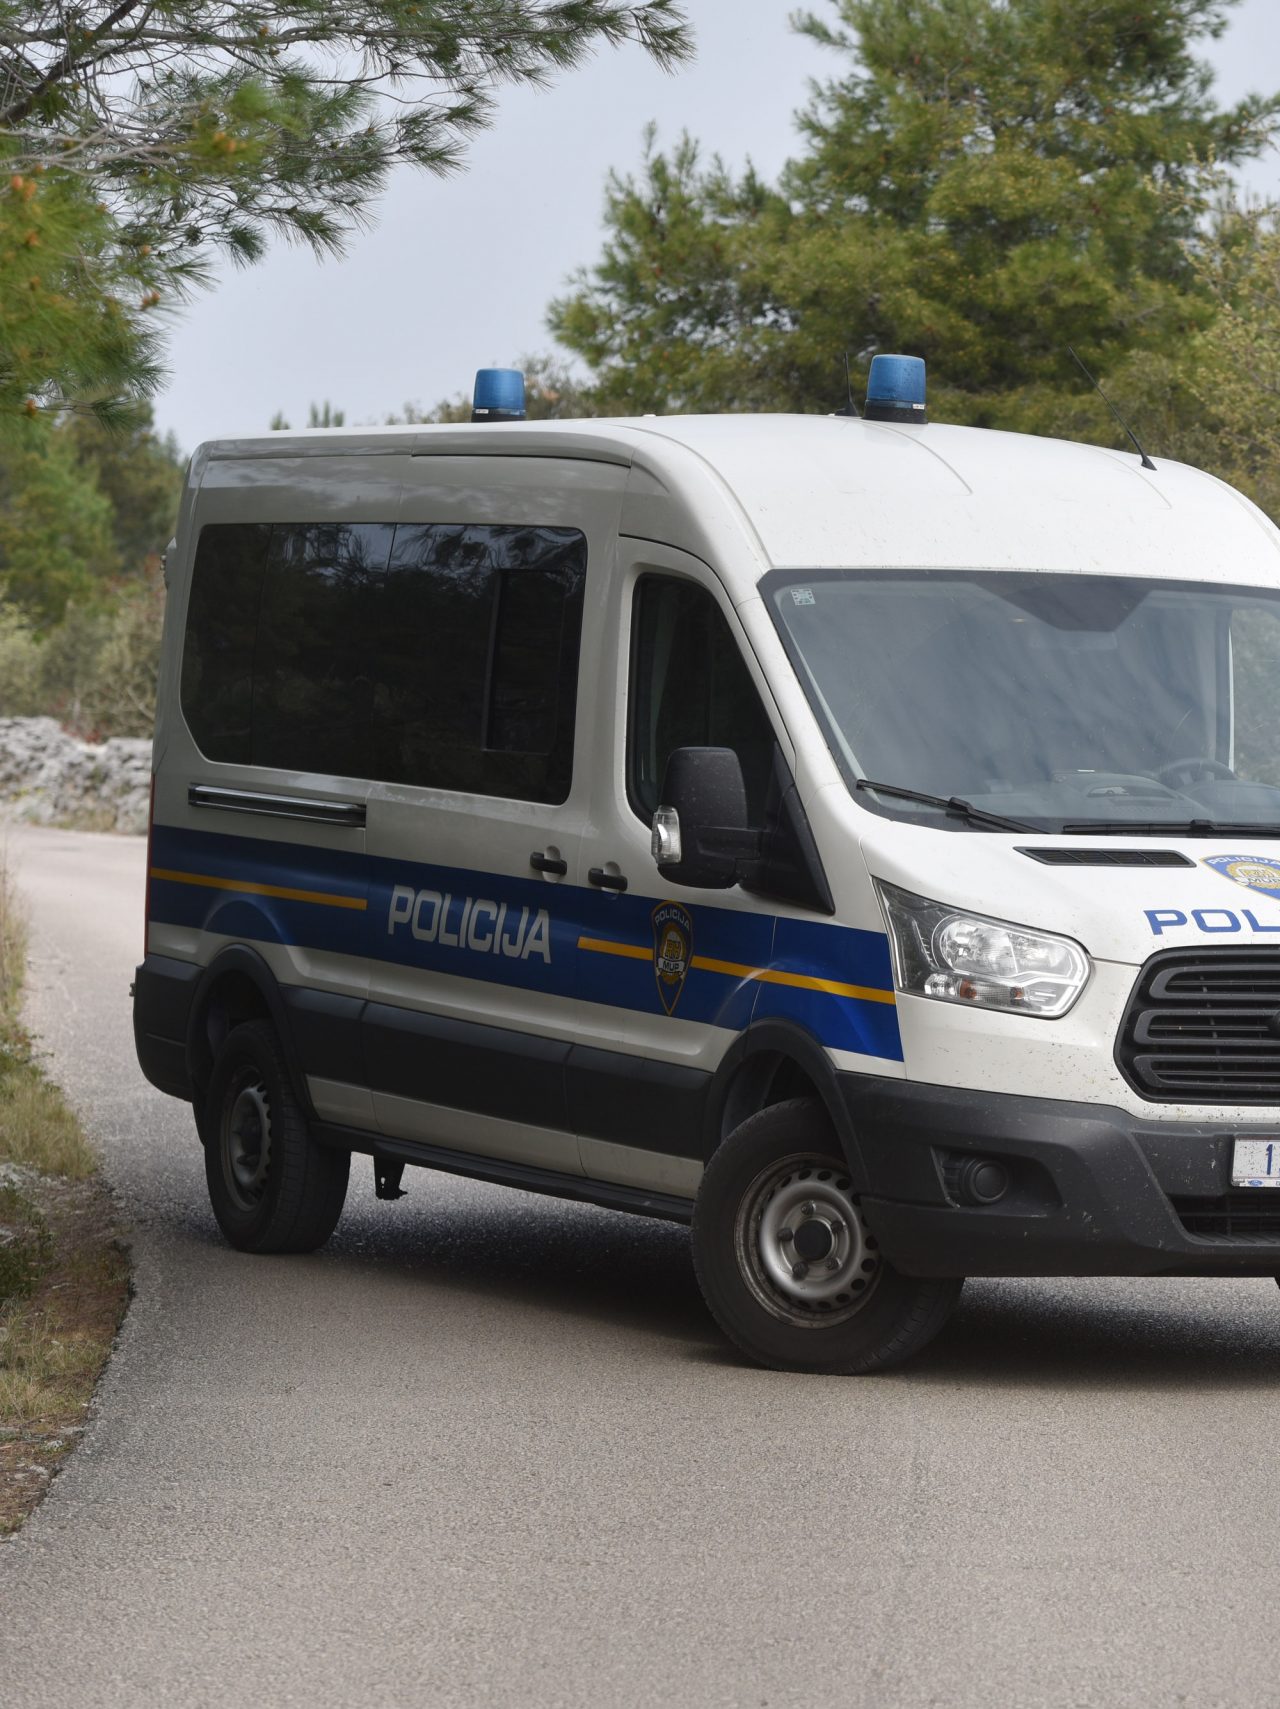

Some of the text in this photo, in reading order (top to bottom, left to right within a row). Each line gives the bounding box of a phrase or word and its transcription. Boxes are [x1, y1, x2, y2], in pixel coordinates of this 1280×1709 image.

[387, 884, 552, 964] POLICIJA
[655, 908, 690, 931] POLICIJA
[662, 960, 680, 972] MUP
